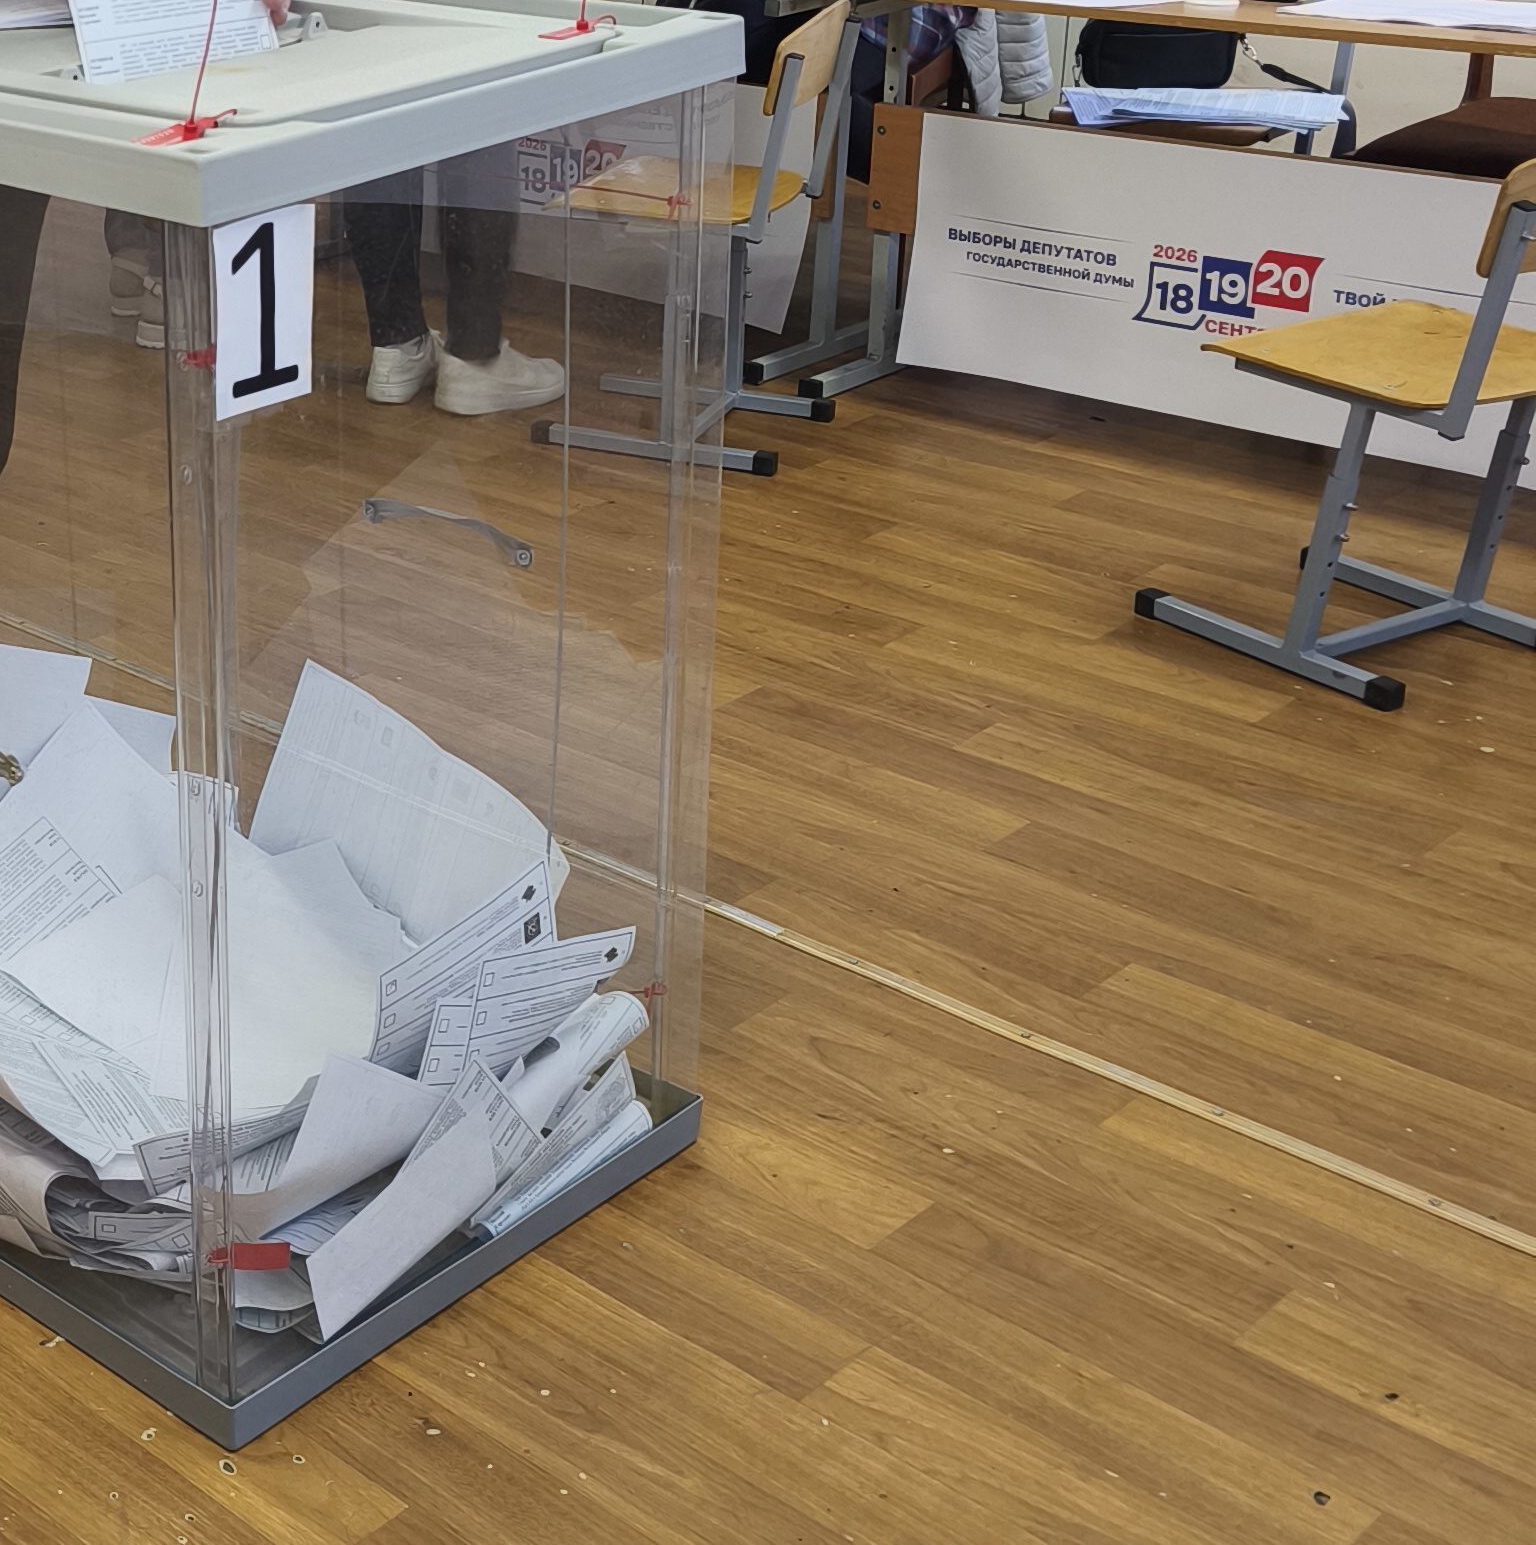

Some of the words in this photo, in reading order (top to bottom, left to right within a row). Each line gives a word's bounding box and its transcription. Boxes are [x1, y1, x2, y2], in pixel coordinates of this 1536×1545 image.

[518, 136, 547, 152] 2026
[520, 165, 546, 193] 18
[552, 157, 579, 186] 19
[585, 149, 617, 175] 20
[948, 227, 1017, 251] ВЫБОРЫ
[1019, 239, 1117, 267] ДЕПУТАТОВ
[1152, 244, 1198, 263] 2026
[965, 250, 1091, 281] ГОСУДАРСТВЕННОЙ
[1092, 272, 1135, 288] ДУМЫ
[1155, 280, 1194, 315] 18
[1204, 270, 1246, 305] 19
[1255, 262, 1310, 299] 20
[1333, 289, 1386, 307] ТВОЙ
[231, 221, 299, 399] 1
[1205, 319, 1266, 337] СЕНТ
